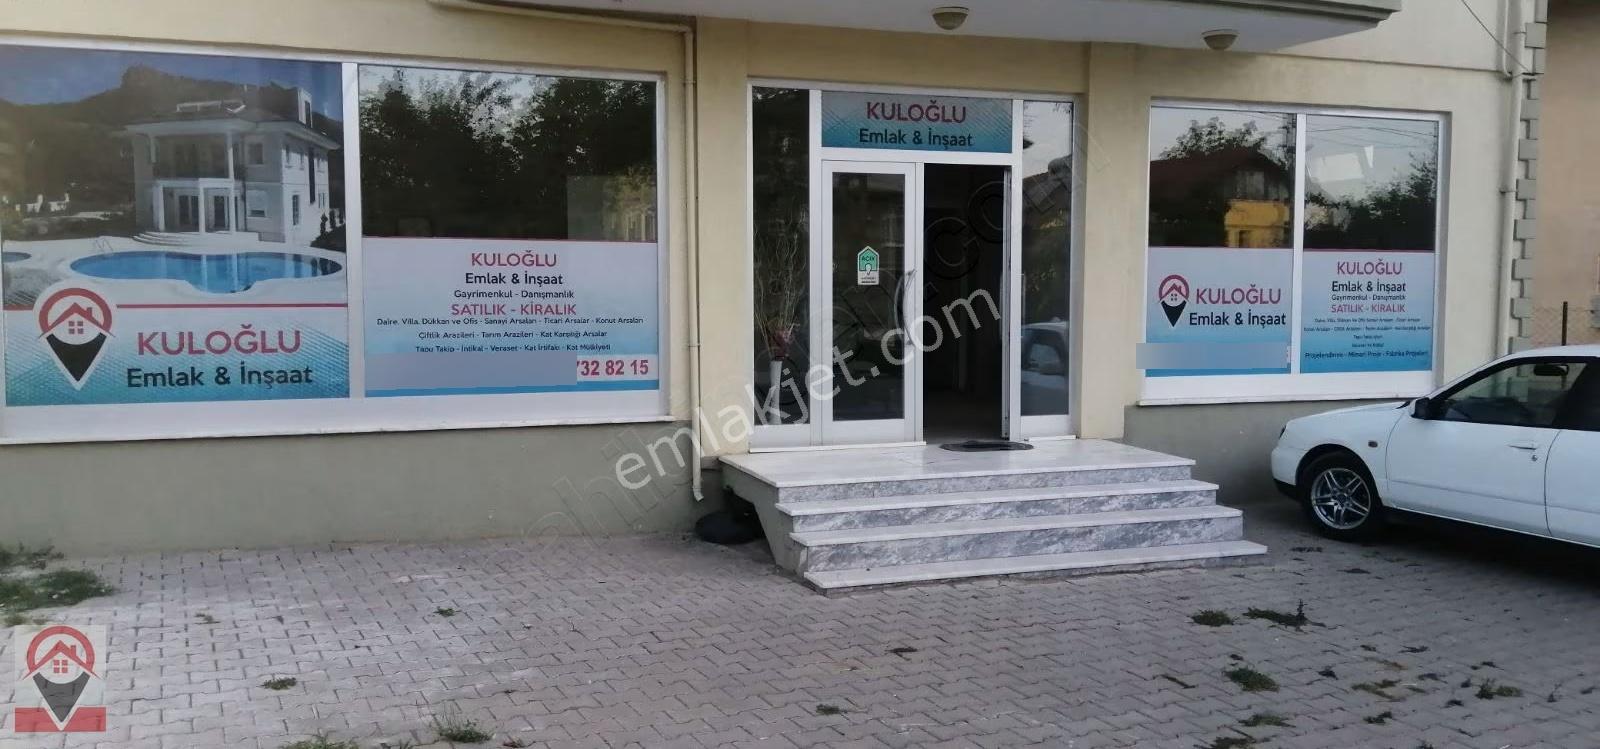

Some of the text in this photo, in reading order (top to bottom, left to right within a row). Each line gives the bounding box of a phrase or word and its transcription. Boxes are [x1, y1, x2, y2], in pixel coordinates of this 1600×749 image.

[867, 100, 966, 123] KULOĞLU
[859, 128, 973, 150] Emlak & İnşaat
[471, 250, 557, 267] KULOĞLU
[1337, 258, 1402, 275] KULOĞLU
[465, 270, 563, 287] Emlak & İnşaat
[1332, 279, 1406, 294] Emlak & İnşaat
[454, 290, 513, 300] Gayrimenkul
[521, 290, 574, 300] Danışmanlık
[1196, 284, 1281, 305] KULOĞLU
[451, 304, 506, 315] SATILIK
[520, 301, 577, 315] KİRALIK
[1331, 304, 1364, 313] SATILIK
[1189, 309, 1286, 328] Emlak & İnşaat
[138, 324, 300, 355] KULOĞLU
[127, 360, 313, 389] Emlak & İnşaat
[577, 360, 649, 376] 32 82 15
